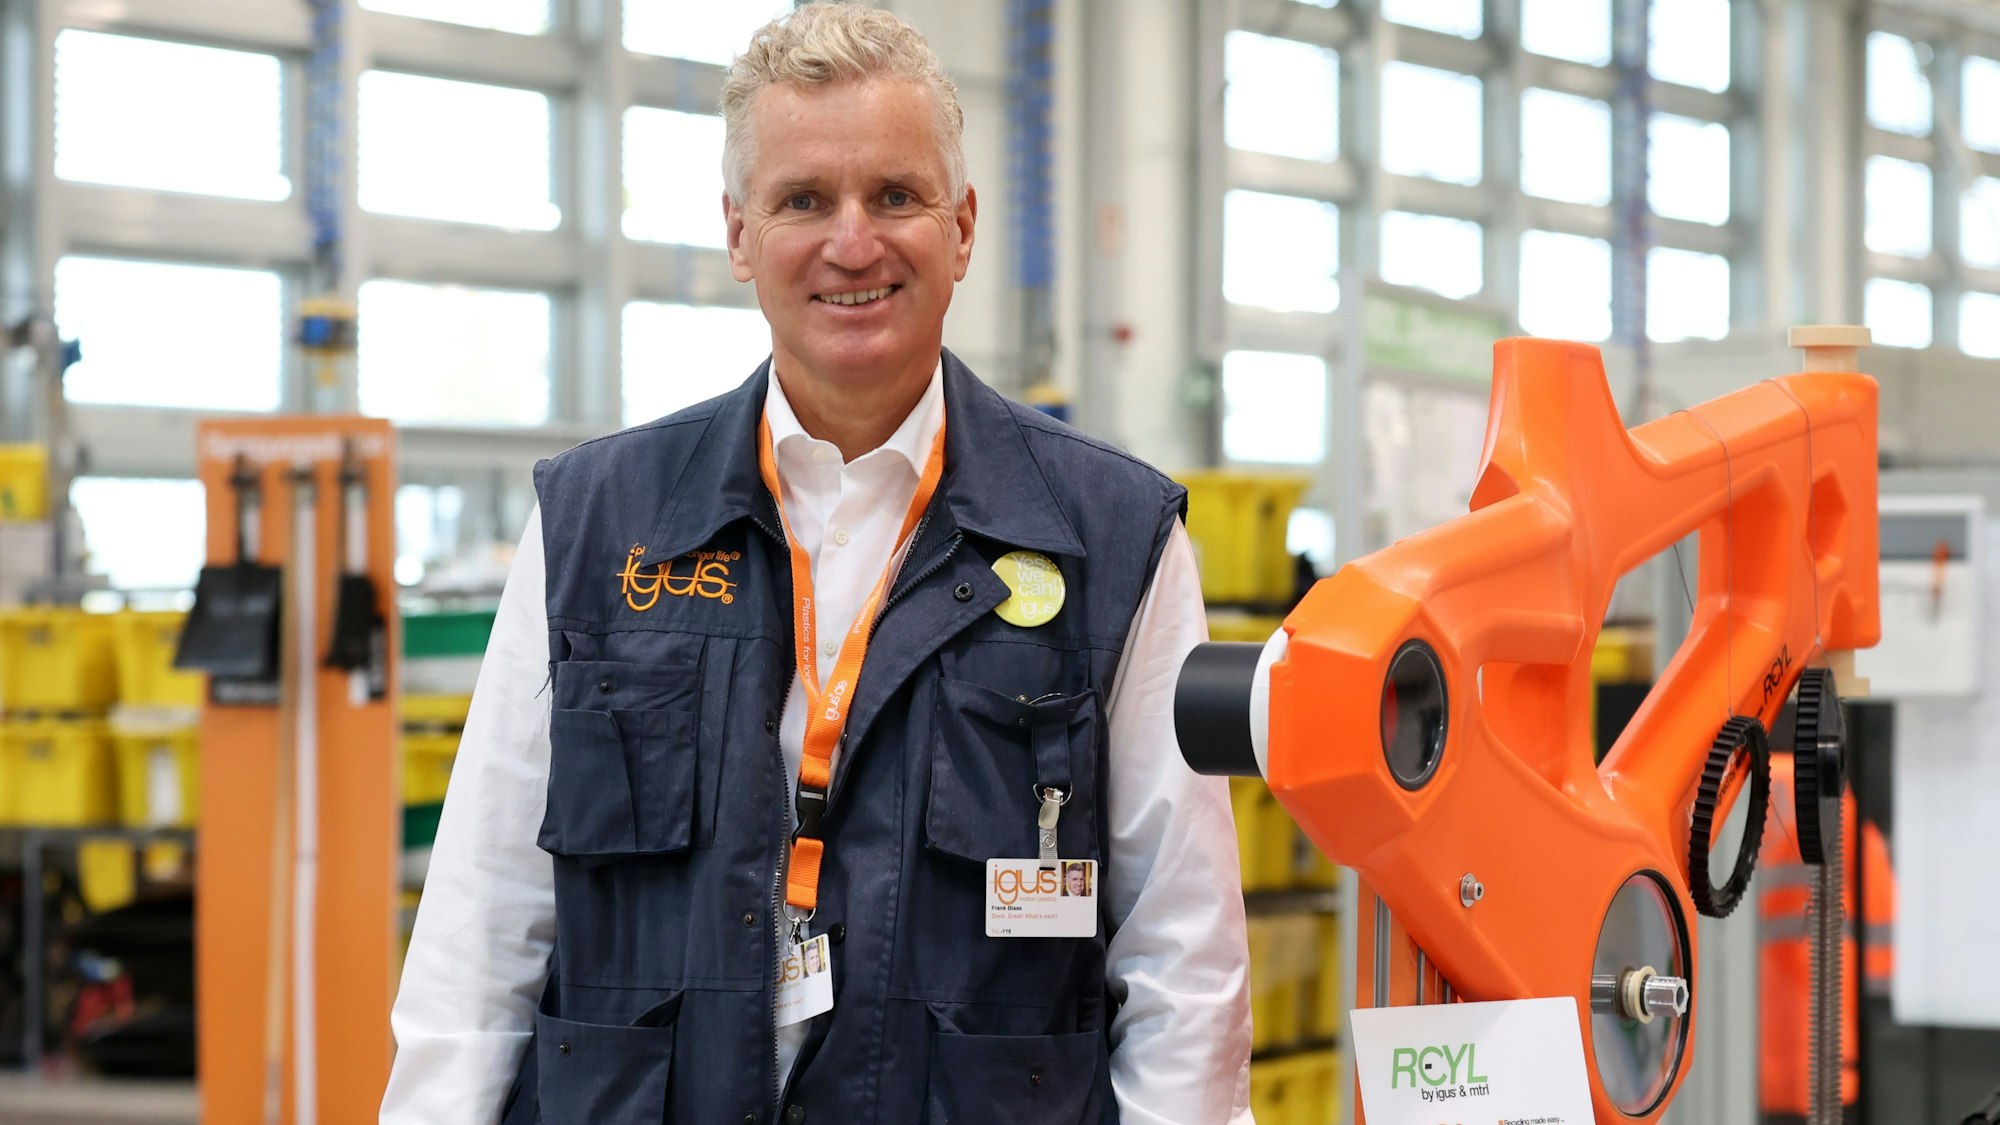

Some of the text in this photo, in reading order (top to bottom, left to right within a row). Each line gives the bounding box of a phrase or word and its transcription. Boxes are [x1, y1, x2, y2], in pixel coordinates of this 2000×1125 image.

[687, 549, 714, 562] onger
[1011, 554, 1050, 572] Yes,
[1016, 569, 1046, 583] we
[1018, 579, 1057, 597] can!
[802, 597, 812, 643] Plastics
[802, 646, 812, 661] for
[1762, 643, 1793, 705] RCYL
[992, 863, 1059, 906] igus
[1391, 1043, 1489, 1089] RCYL
[1421, 1088, 1434, 1103] by
[1459, 1085, 1467, 1097] &
[1469, 1083, 1490, 1096] mtrl
